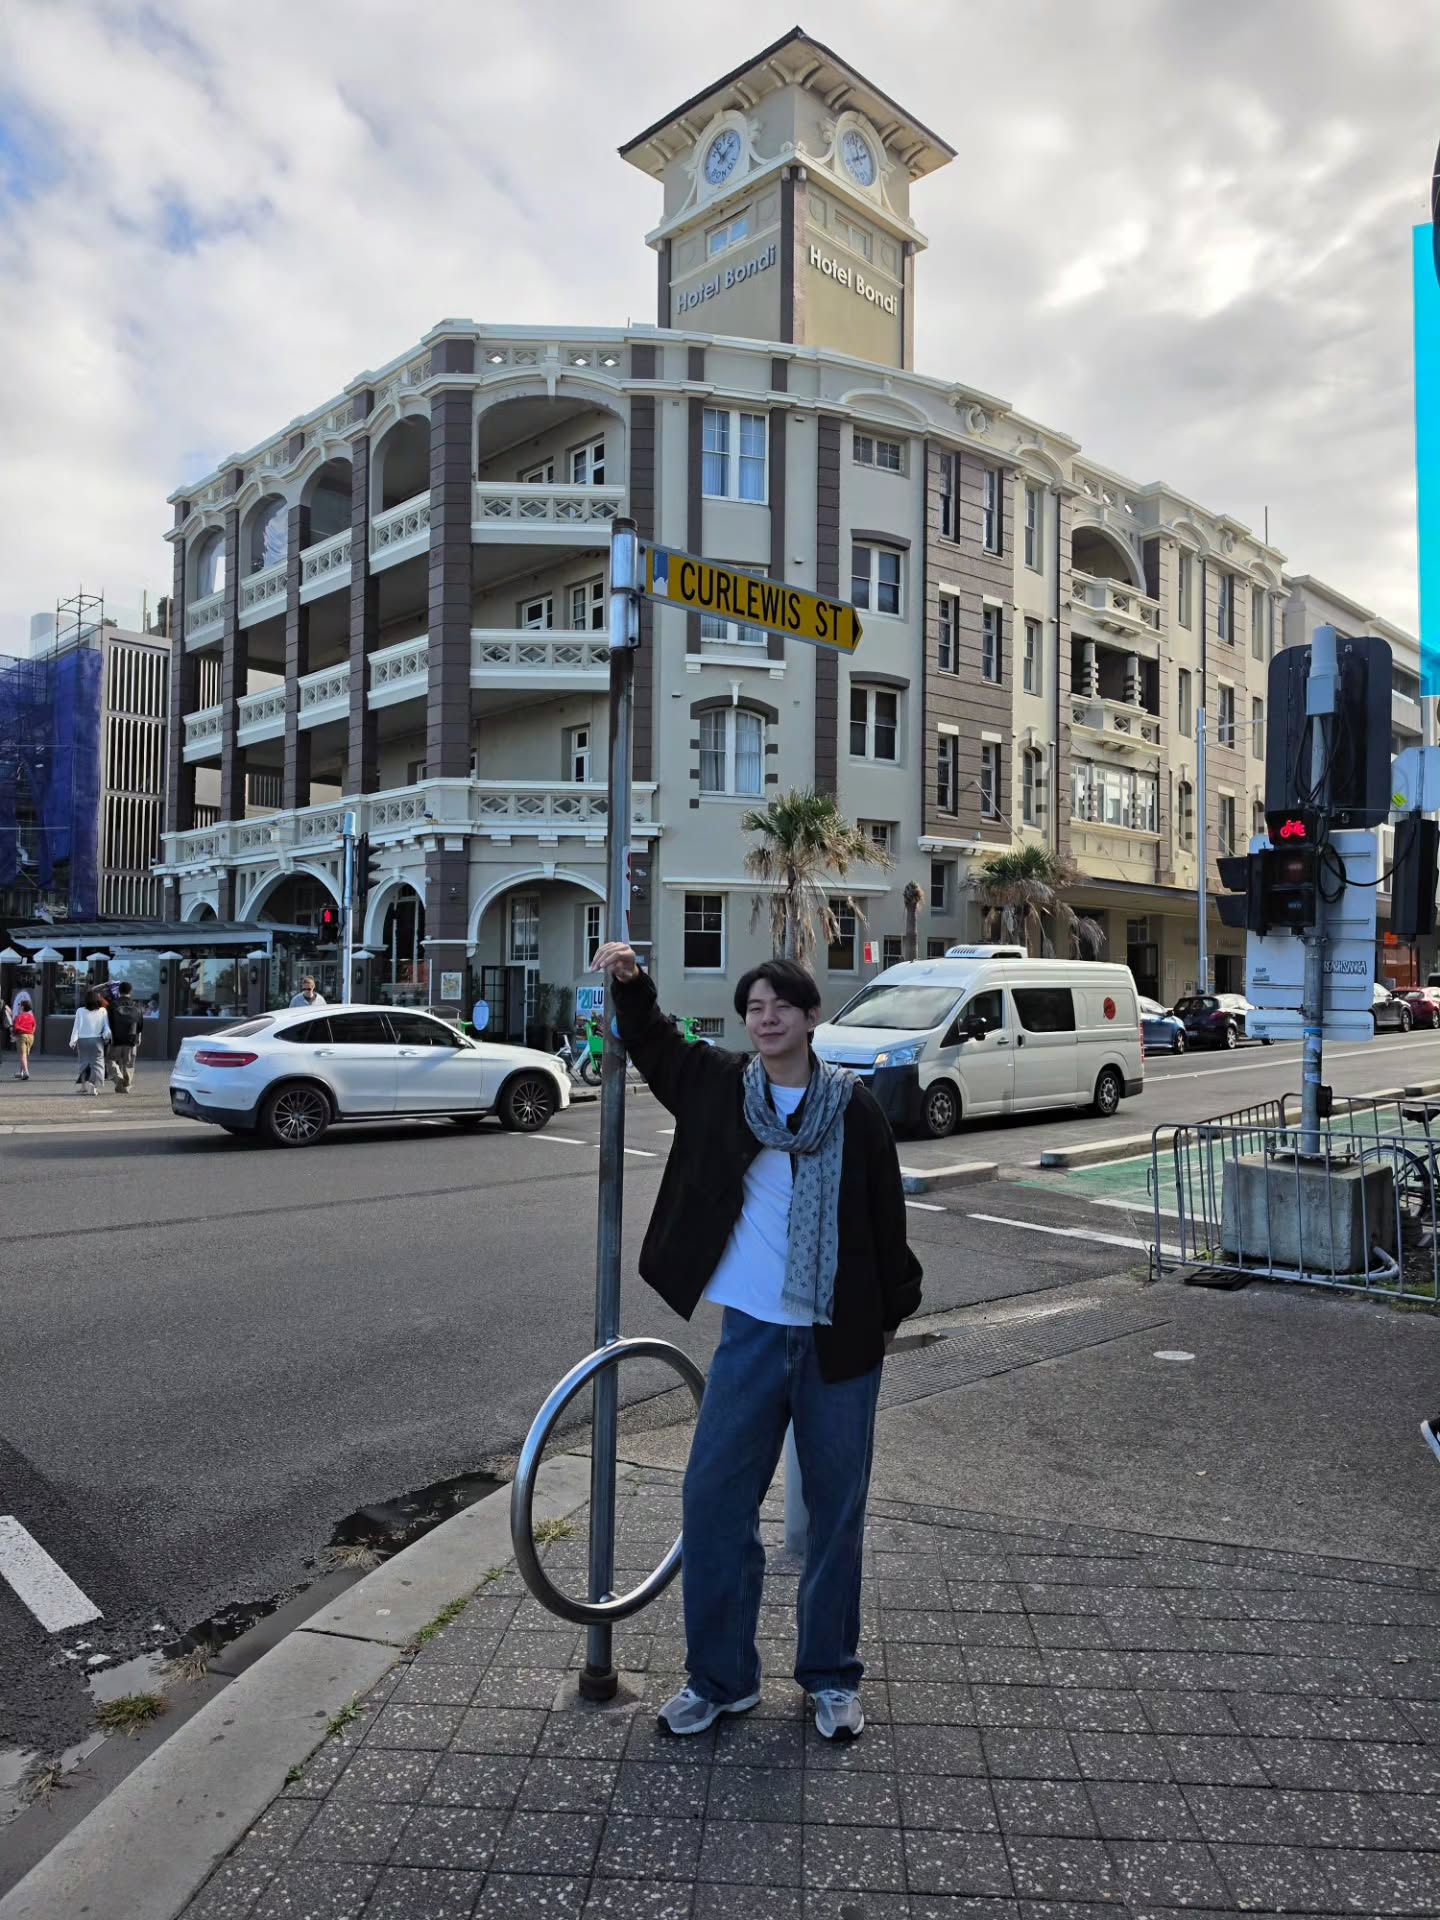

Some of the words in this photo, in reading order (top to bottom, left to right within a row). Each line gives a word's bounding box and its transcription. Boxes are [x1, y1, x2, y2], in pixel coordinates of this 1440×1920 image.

[677, 273, 720, 315] Hotel
[724, 243, 776, 290] Bondi
[810, 244, 852, 289] Hotel
[856, 273, 898, 317] Bondi
[680, 561, 801, 630] CURLEWIS
[815, 600, 843, 642] ST
